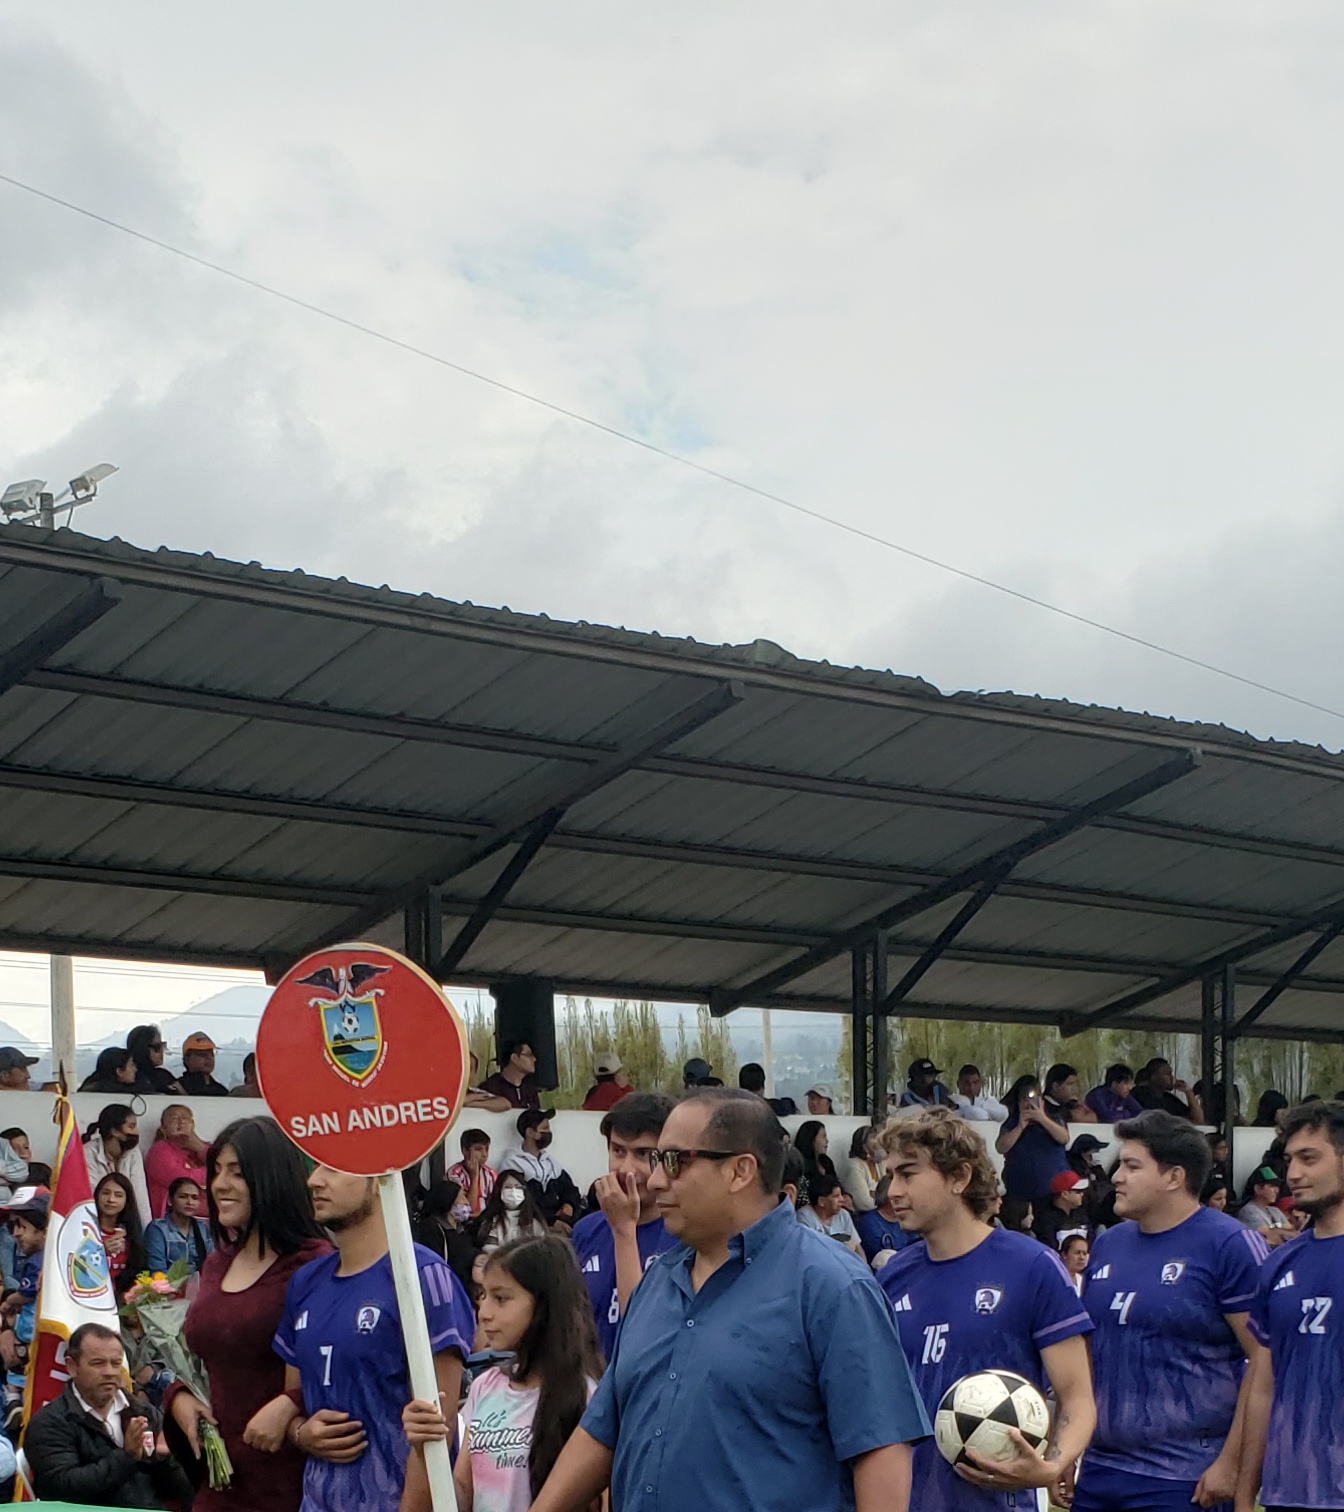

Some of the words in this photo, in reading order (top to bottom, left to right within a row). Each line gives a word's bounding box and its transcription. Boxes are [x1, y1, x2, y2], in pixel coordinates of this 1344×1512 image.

[290, 1111, 341, 1138] SAN
[347, 1097, 450, 1132] ANDRES
[1109, 1291, 1136, 1325] 4
[1298, 1297, 1333, 1334] 22
[921, 1322, 950, 1365] 16
[319, 1344, 334, 1386] 7
[481, 1409, 507, 1428] It's
